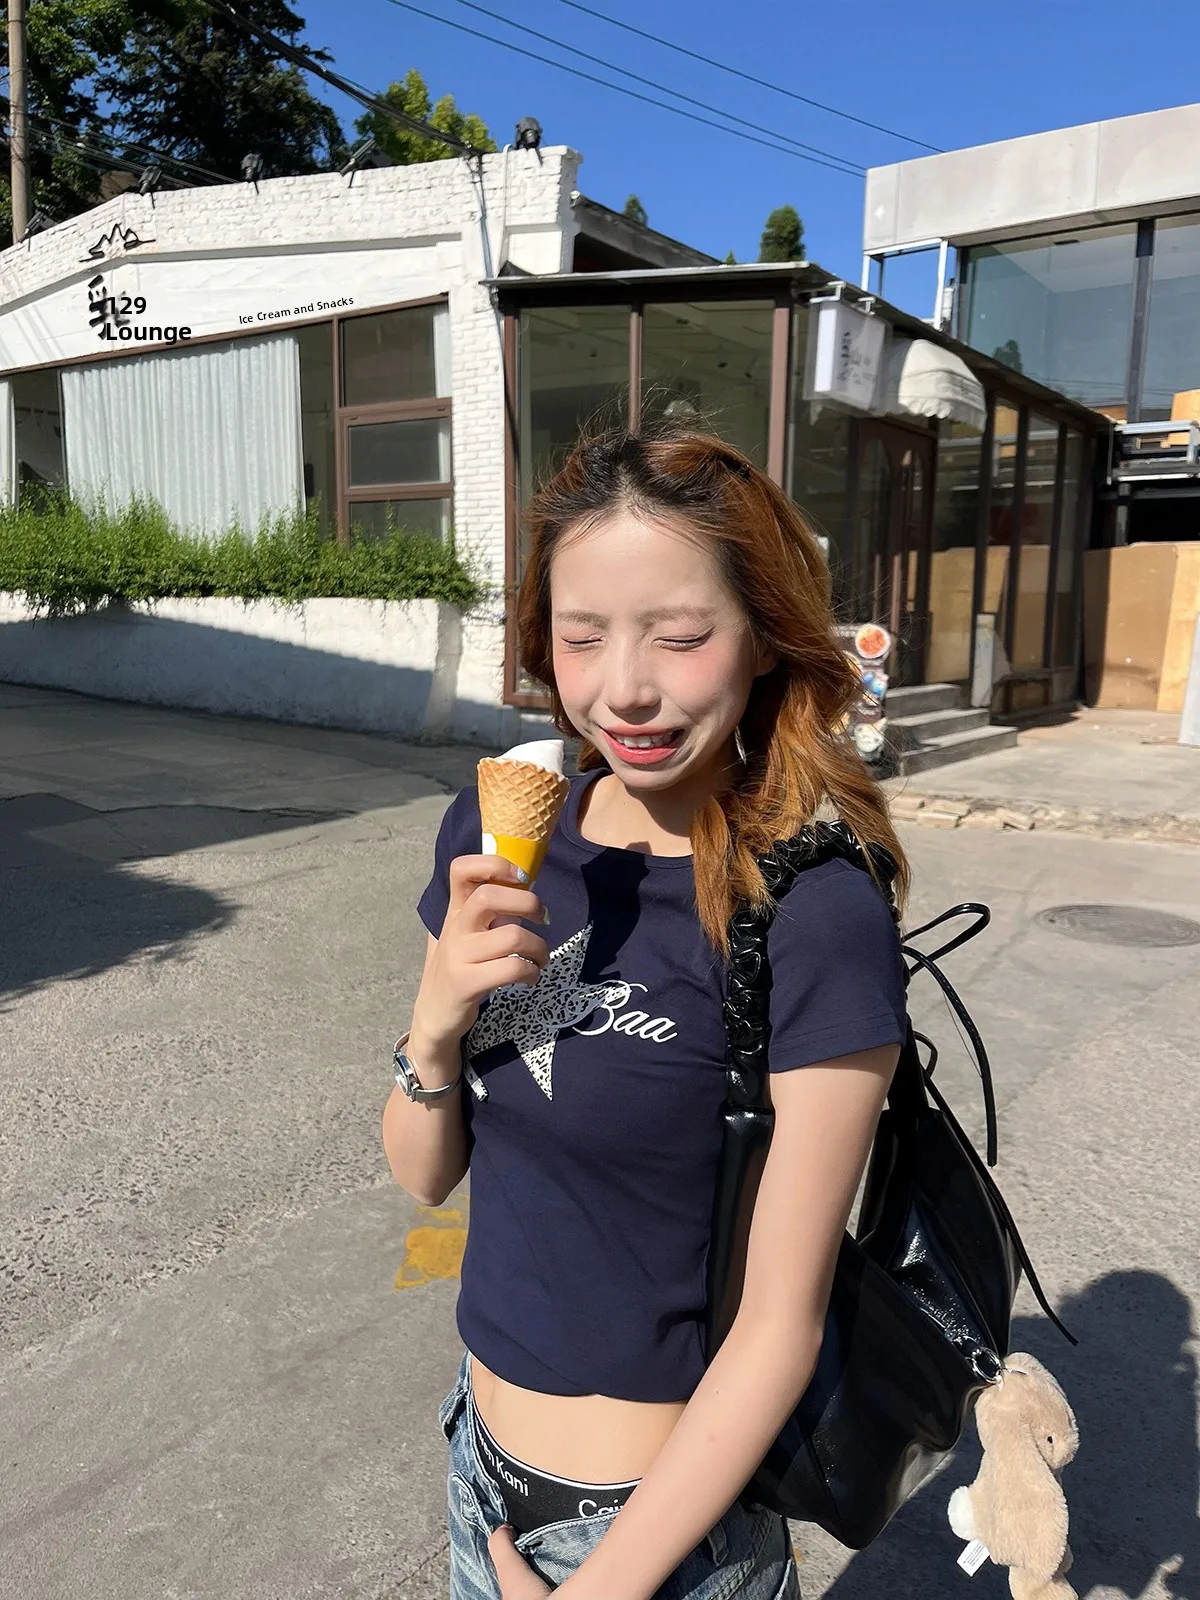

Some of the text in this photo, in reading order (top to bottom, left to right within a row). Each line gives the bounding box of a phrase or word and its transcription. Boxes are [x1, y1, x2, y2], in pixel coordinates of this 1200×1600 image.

[107, 296, 147, 315] 129
[239, 297, 354, 324] Ice Cream and Snacks
[106, 322, 192, 345] Lounge
[496, 1456, 529, 1497] Kani
